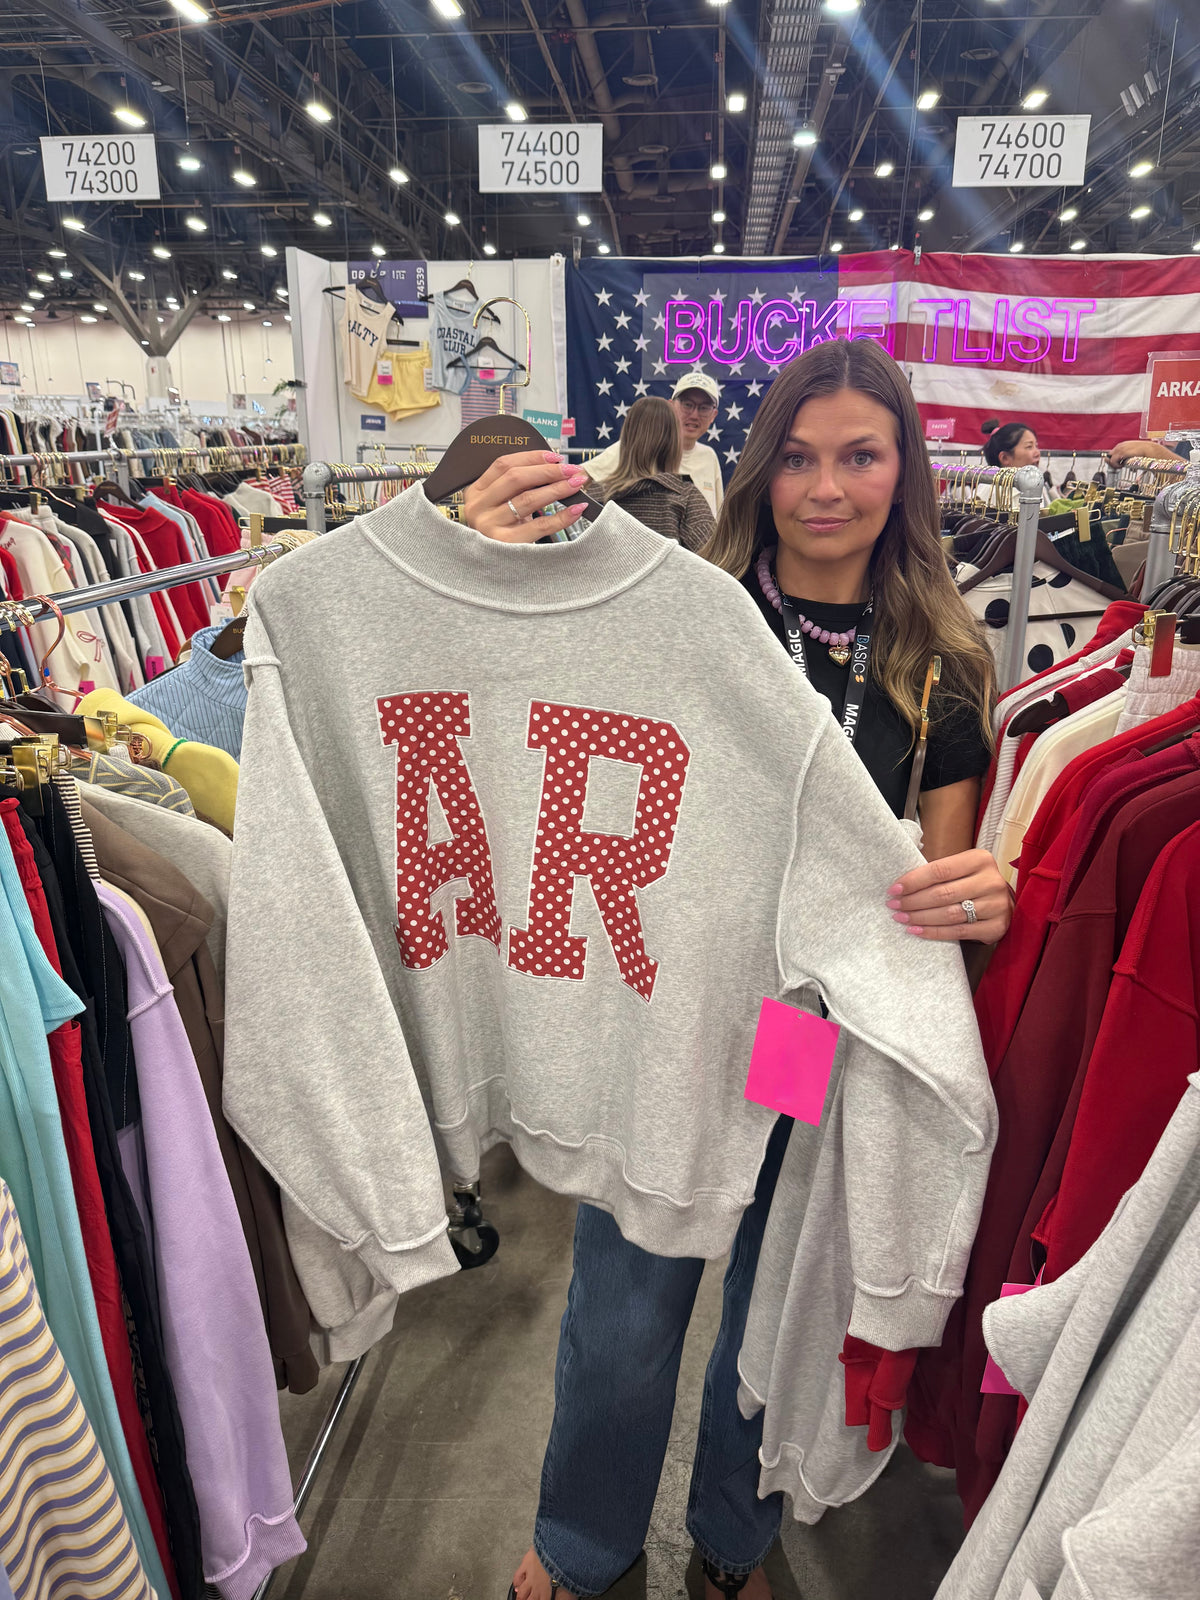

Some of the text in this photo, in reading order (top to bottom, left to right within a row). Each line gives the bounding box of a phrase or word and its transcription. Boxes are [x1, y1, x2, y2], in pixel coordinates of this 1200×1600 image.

[501, 131, 580, 157] 74400
[981, 122, 1065, 149] 74600
[62, 141, 136, 167] 74200
[978, 152, 1062, 179] 74700
[65, 169, 139, 195] 74300
[501, 160, 580, 186] 74500
[416, 267, 425, 298] 74539
[436, 327, 476, 348] COASTAL
[443, 339, 466, 355] CLUB
[526, 416, 558, 427] BLANKS
[470, 434, 531, 446] BUCKETLIST
[375, 690, 692, 1004] AR
